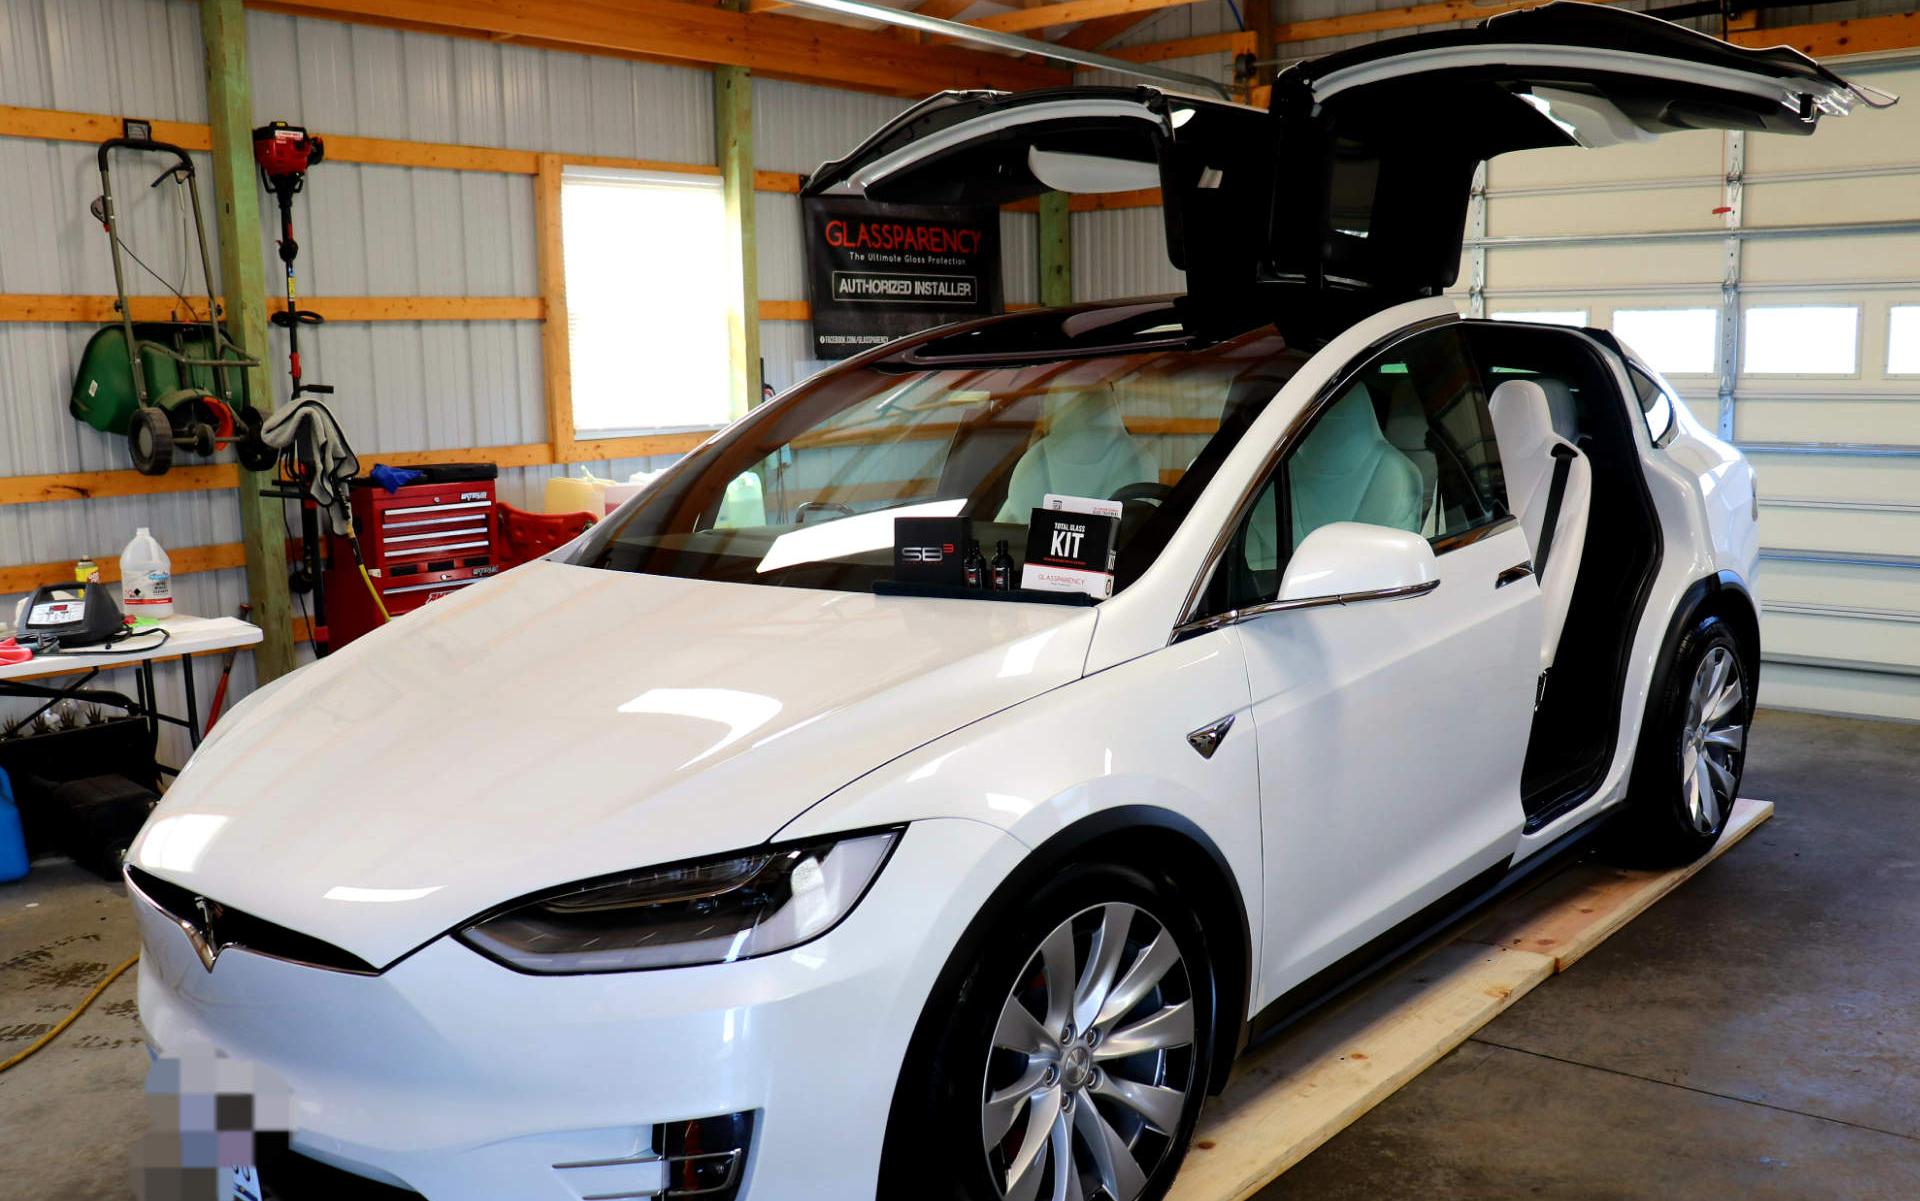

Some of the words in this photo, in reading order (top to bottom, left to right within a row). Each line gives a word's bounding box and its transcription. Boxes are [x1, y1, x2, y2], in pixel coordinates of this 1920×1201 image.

[825, 219, 983, 254] GLASSPARENCY
[849, 251, 865, 261] The
[867, 253, 901, 263] Ultimate
[904, 254, 925, 264] Glass
[928, 255, 966, 266] Protection
[839, 278, 912, 295] AUTHORIZED
[914, 281, 972, 297] INSTALLER
[1054, 522, 1069, 531] TOTAL
[1069, 524, 1086, 532] GLASS
[1050, 530, 1085, 559] KIT
